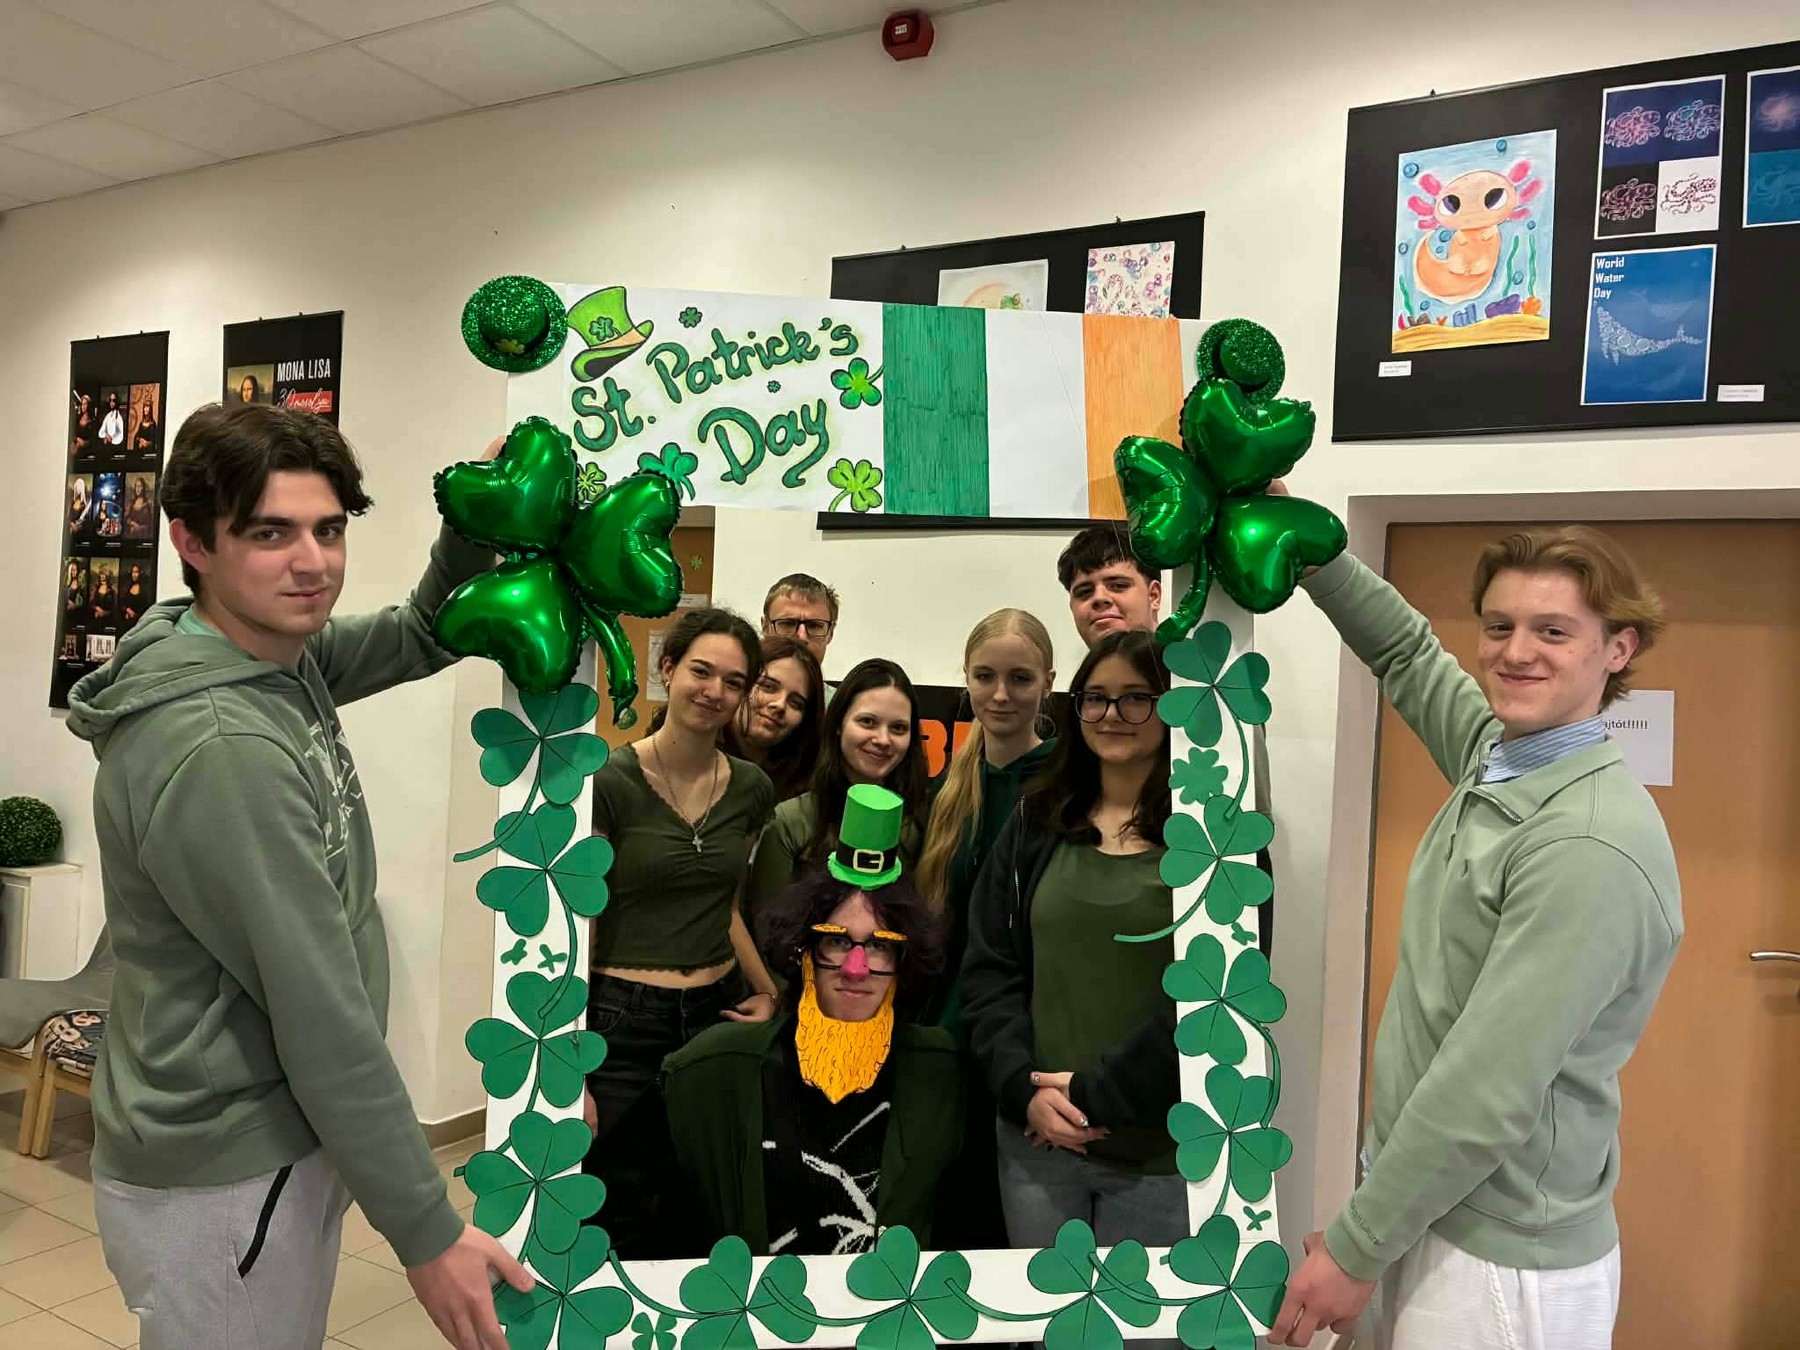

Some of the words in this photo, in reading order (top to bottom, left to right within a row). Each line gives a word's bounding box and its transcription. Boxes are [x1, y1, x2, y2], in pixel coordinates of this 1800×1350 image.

[1596, 256, 1625, 269] World
[1595, 272, 1625, 283] Water
[1593, 287, 1612, 300] Day
[277, 360, 305, 382] MONA
[308, 358, 331, 379] LISA
[571, 377, 656, 452] St.
[646, 317, 859, 404] Patrick's
[697, 398, 830, 488] Day
